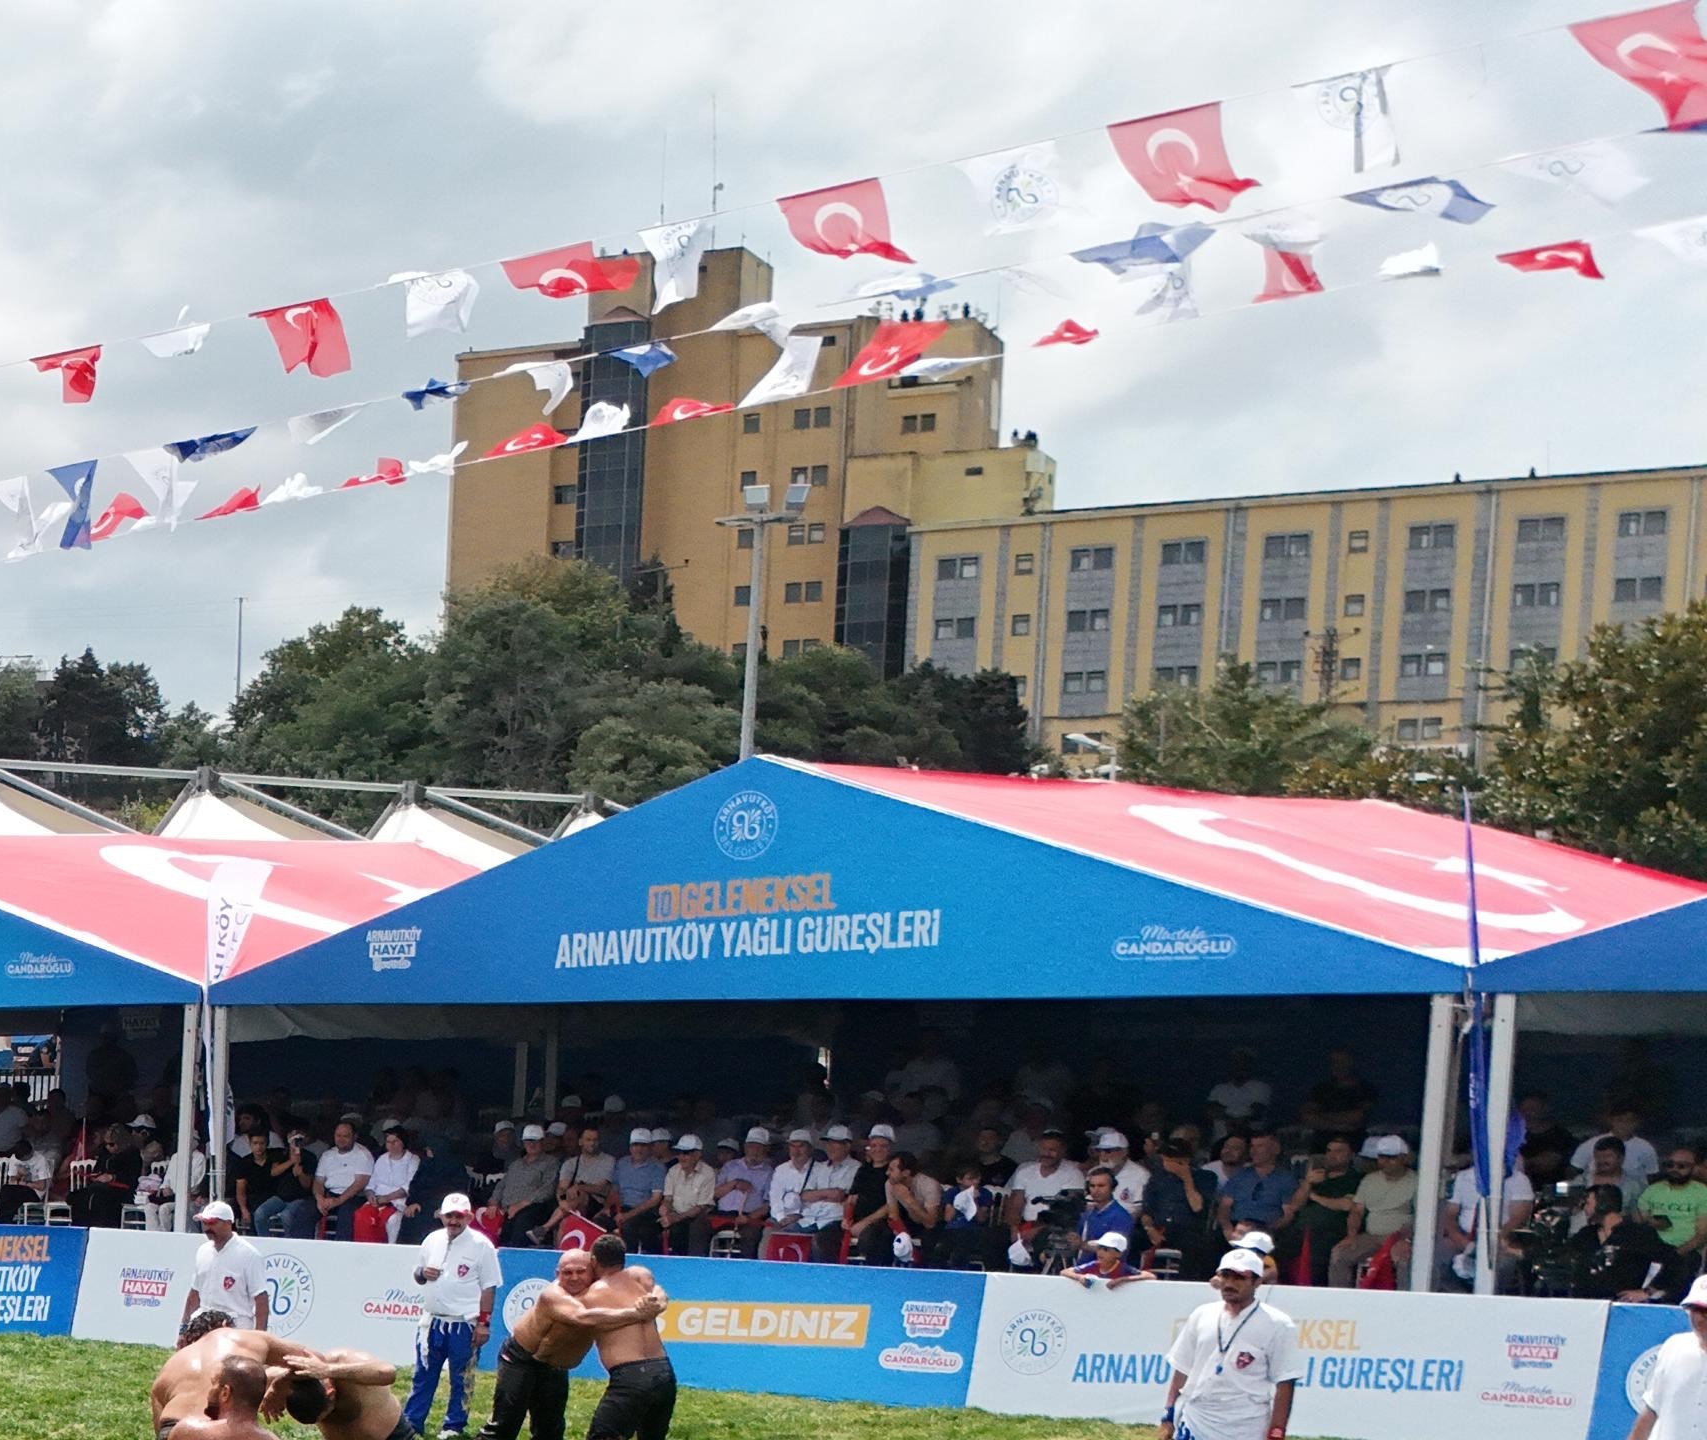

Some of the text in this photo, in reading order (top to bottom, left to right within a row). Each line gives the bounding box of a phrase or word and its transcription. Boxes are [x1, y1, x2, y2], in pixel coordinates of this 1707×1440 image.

[681, 873, 836, 918] GELENEKSEL
[366, 926, 422, 942] ARNAVUTKÖY
[555, 910, 940, 969] ARNAVUTKÖY YAĞLI GÜREŞLERİ
[372, 944, 414, 955] HAYAT
[1116, 939, 1231, 954] CANDAROĞLU
[120, 1266, 175, 1280] ARNAVUTKÖY
[124, 1282, 166, 1294] HAYAT
[385, 1288, 425, 1303] Musta
[363, 1302, 423, 1317] CANDAR
[677, 1307, 859, 1340] GELDİNİZ
[909, 1315, 945, 1326] HAYAT
[1505, 1333, 1567, 1345] ARNAVUTKÖY
[883, 1353, 957, 1368] CANDAROĞLU
[1509, 1347, 1558, 1359] HAYAT
[1072, 1353, 1170, 1385] ARNAVU
[1319, 1357, 1464, 1392] GÜREŞLERİ
[1481, 1391, 1572, 1406] CANDAROĞLU
